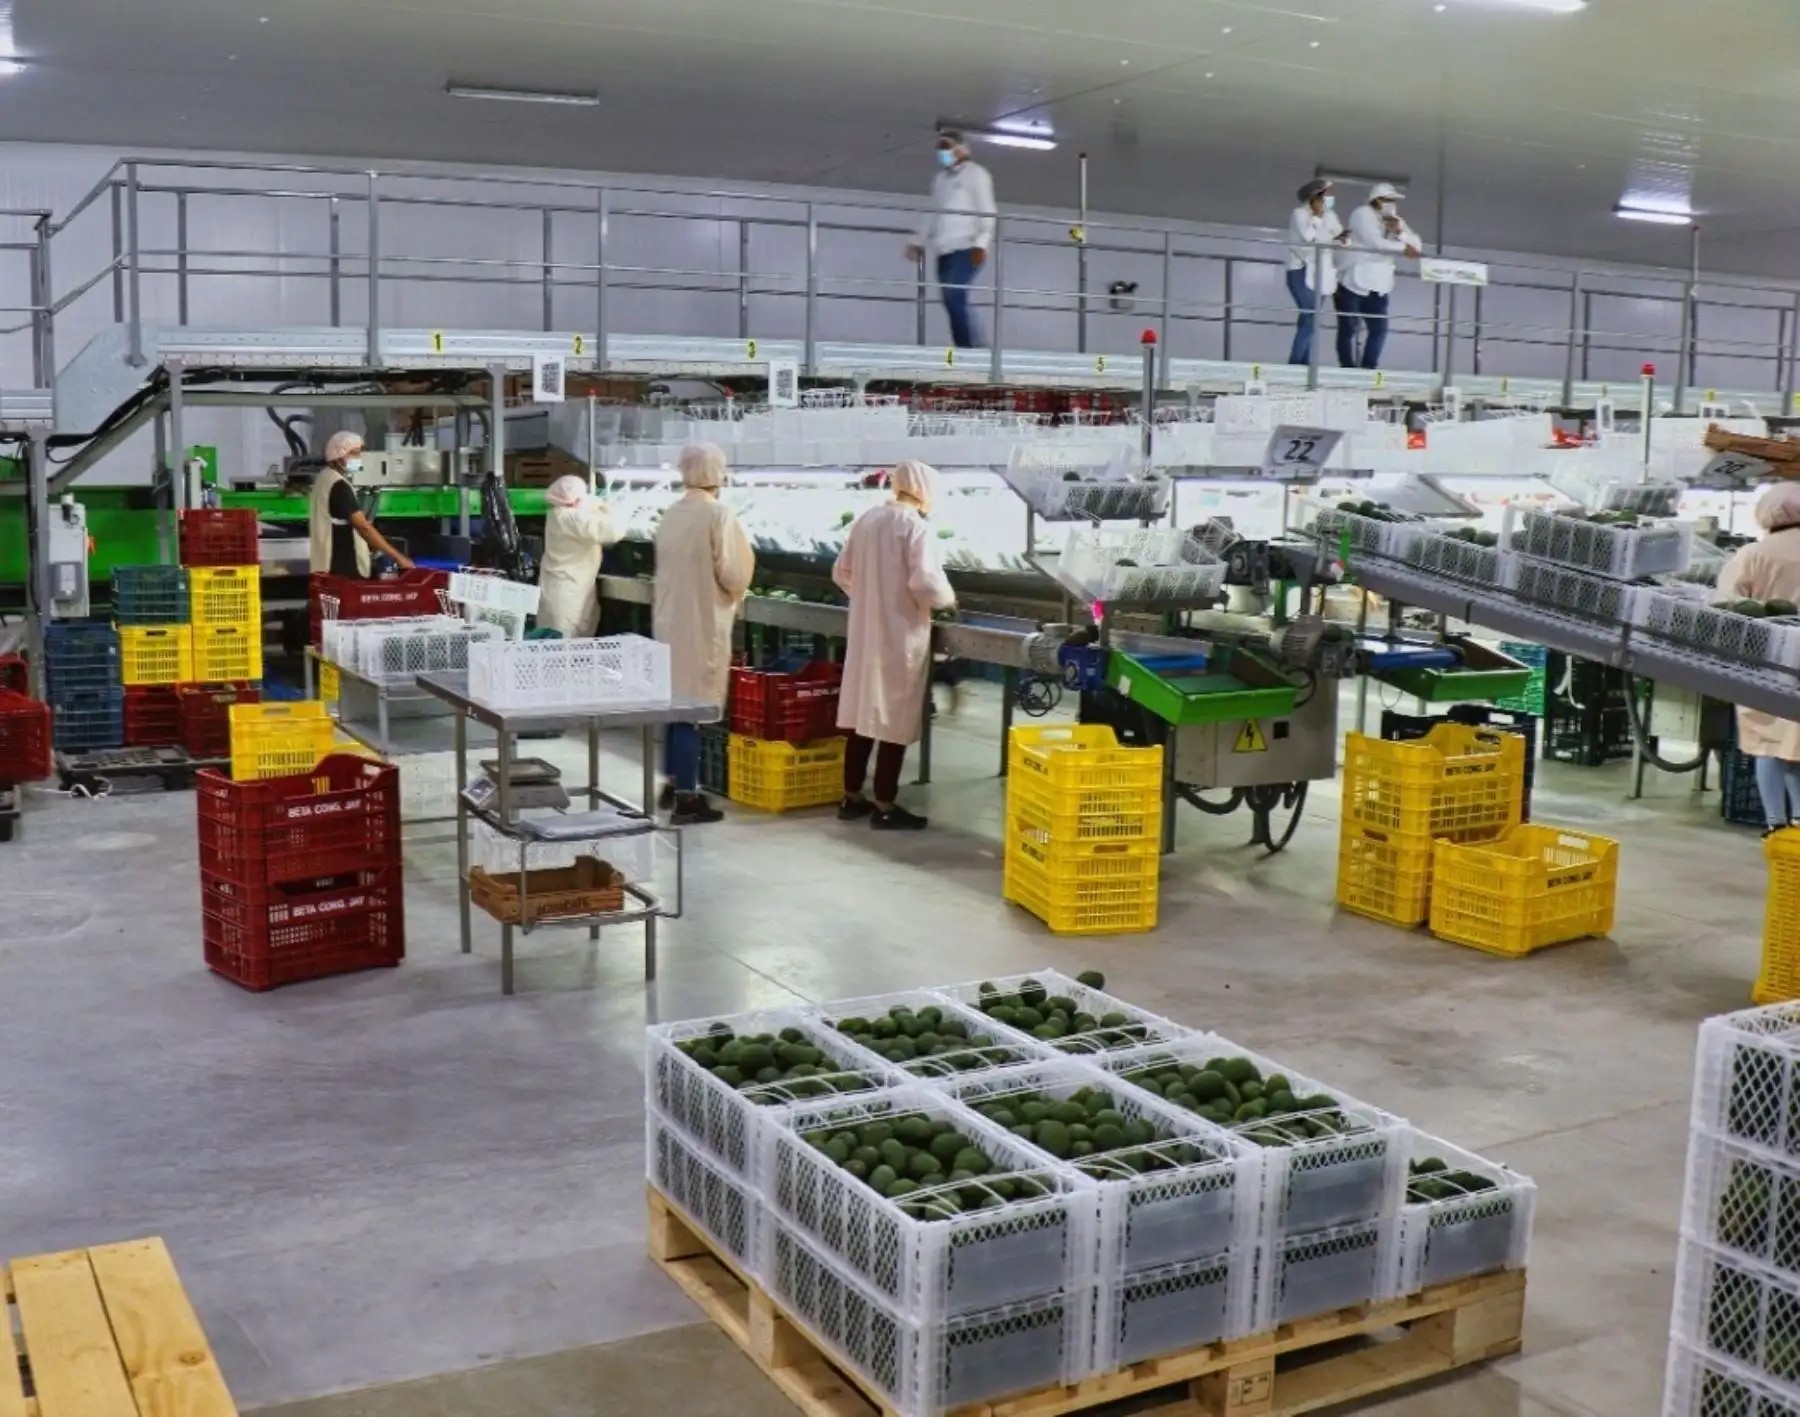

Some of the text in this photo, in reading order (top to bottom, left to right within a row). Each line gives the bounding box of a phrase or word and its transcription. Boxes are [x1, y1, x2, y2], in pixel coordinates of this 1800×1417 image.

[1283, 439, 1316, 461] 22
[287, 805, 312, 818] BETA
[292, 904, 317, 918] BETA
